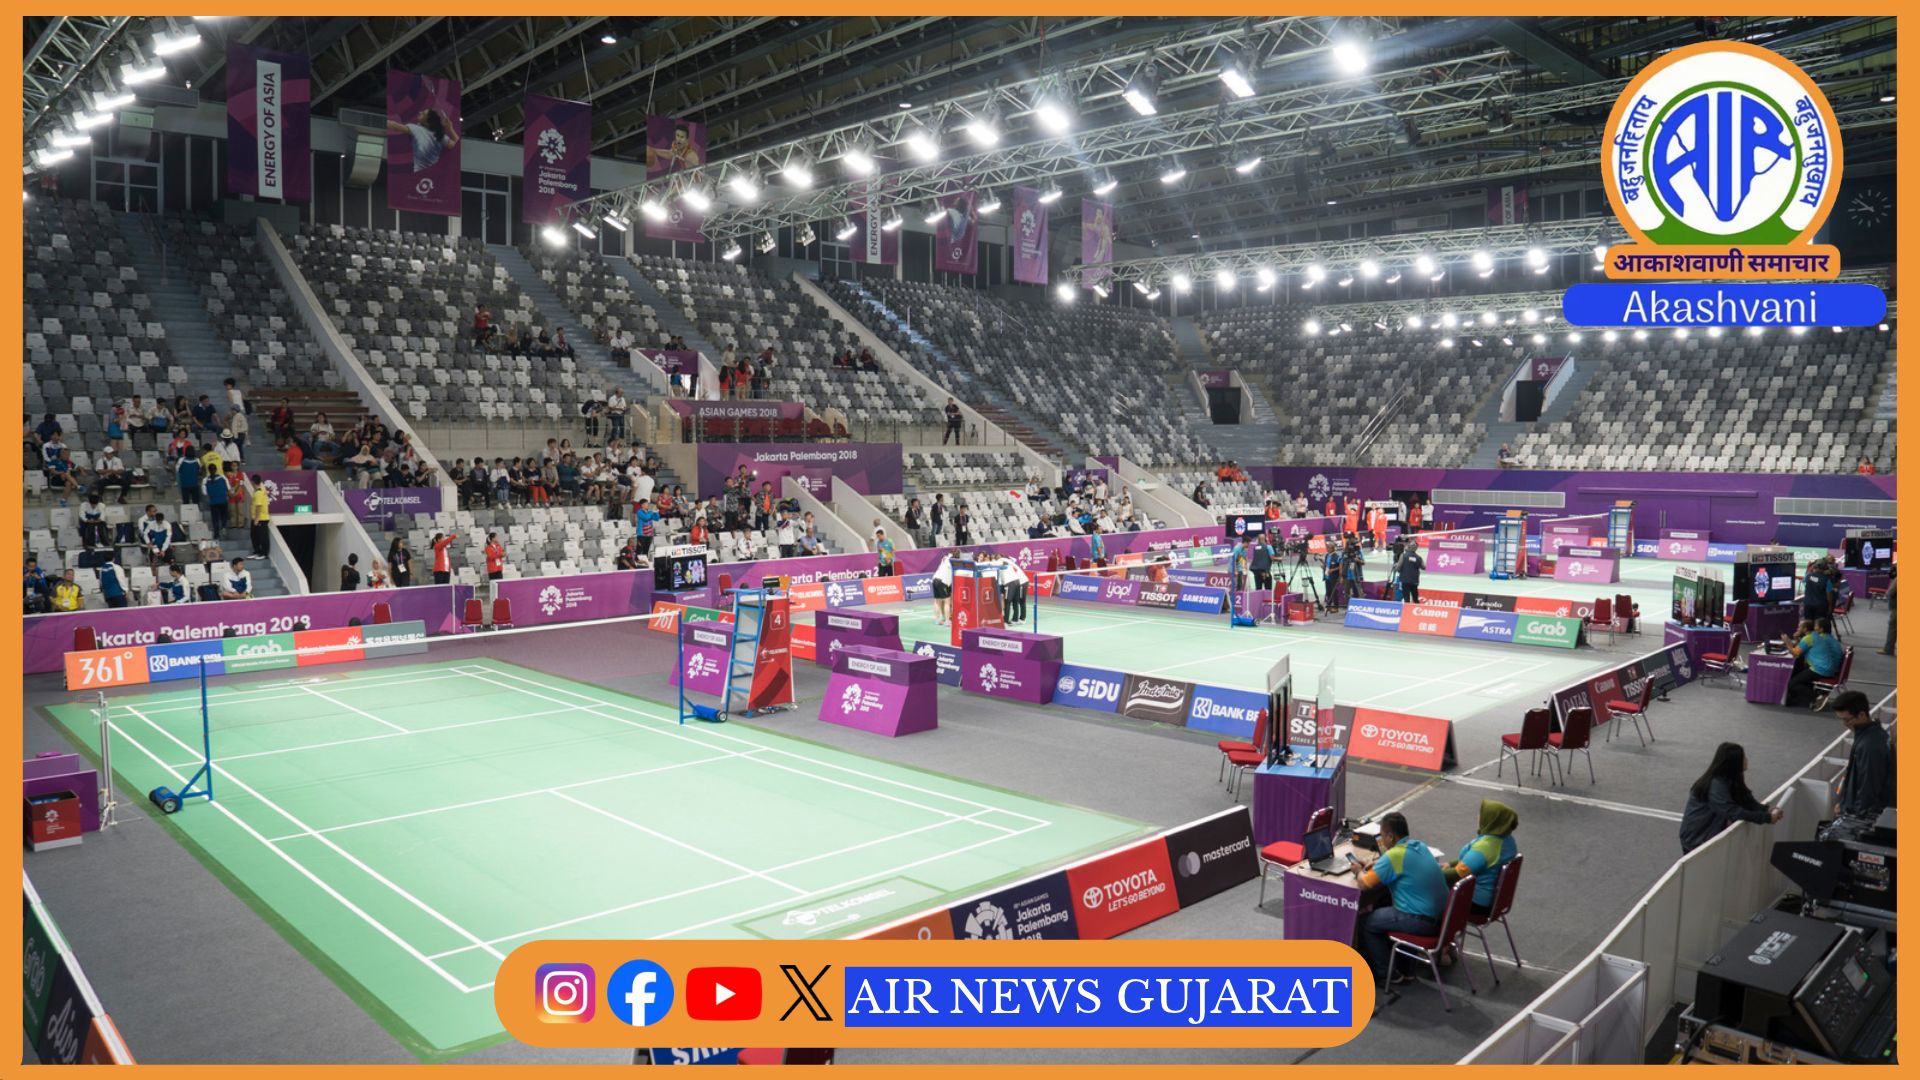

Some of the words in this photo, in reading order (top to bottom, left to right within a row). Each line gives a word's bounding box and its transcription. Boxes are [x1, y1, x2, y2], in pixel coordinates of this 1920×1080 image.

[263, 72, 275, 107] ASIA
[263, 108, 275, 131] OF
[263, 130, 276, 188] ENERGY
[538, 169, 566, 180] Jakarta
[538, 178, 578, 191] Palembang
[538, 186, 555, 195] 2018
[870, 215, 878, 256] ENERGY
[700, 407, 725, 417] ASIAN
[727, 407, 758, 417] GAMES
[759, 408, 778, 417] 2018
[754, 452, 788, 462] Jakarta
[790, 451, 838, 462] Palembang
[839, 451, 858, 460] 2018
[683, 546, 706, 556] TISSOT
[1764, 553, 1794, 562] TISSOT
[1140, 590, 1178, 602] TISSOT
[1182, 593, 1219, 604] SAMSUNG
[1235, 595, 1242, 604] 2
[1375, 607, 1400, 615] SWEAT
[1412, 607, 1448, 618] Canon
[774, 615, 781, 625] 4
[1527, 620, 1567, 636] Grab
[1482, 625, 1512, 636] ASTRA
[79, 651, 133, 685] 361°
[169, 655, 201, 667] BANK
[1077, 677, 1121, 703] SiDU
[1594, 678, 1616, 694] Canon
[1211, 704, 1244, 720] BANK
[1379, 727, 1429, 746] TOYOTA
[1202, 835, 1251, 864] mastercard
[1103, 868, 1158, 899] TOYOTA
[1108, 897, 1128, 912] LET'S
[1127, 894, 1139, 908] GO
[1138, 881, 1166, 905] BEYOND
[1300, 887, 1339, 908] Jakarta
[1016, 903, 1051, 923] Jakarta
[1018, 909, 1069, 936] Palembang
